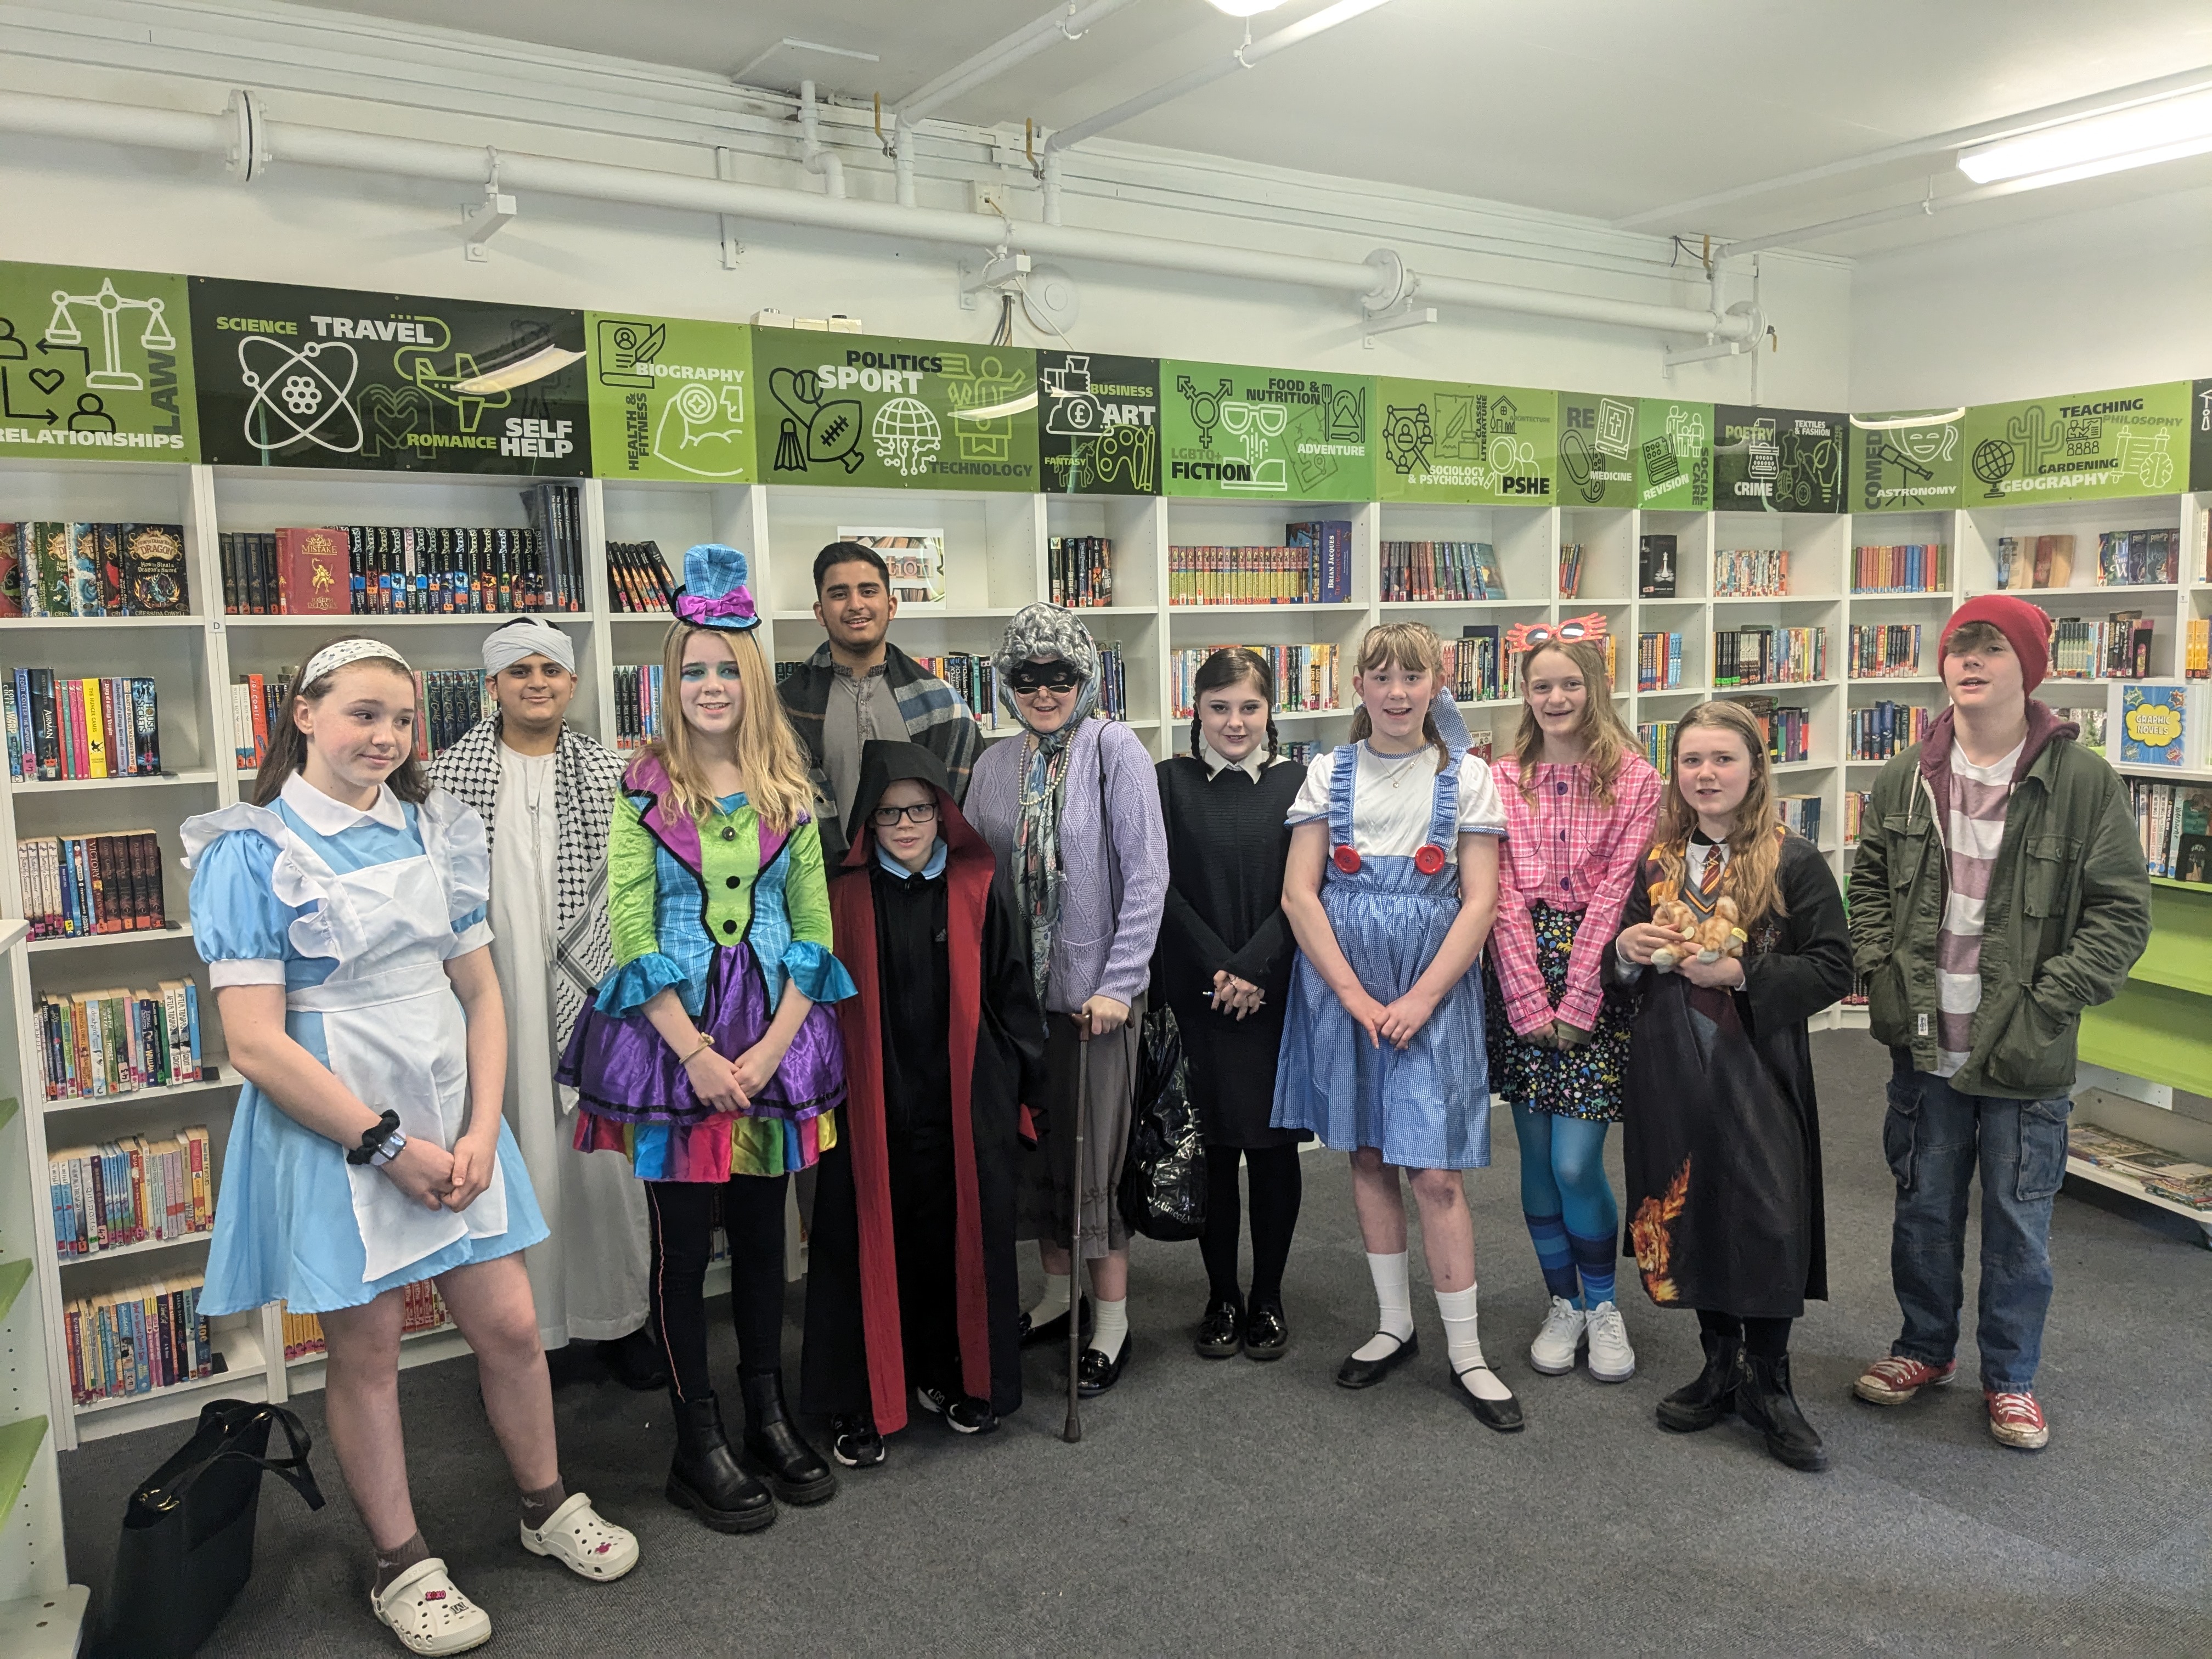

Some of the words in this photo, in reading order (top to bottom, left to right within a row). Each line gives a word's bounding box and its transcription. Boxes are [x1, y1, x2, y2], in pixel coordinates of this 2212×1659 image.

[217, 317, 298, 335] SCIENCE
[311, 315, 433, 344] TRAVEL
[847, 350, 943, 373] POLITICS
[636, 363, 744, 382] BIOGRAPHY
[818, 364, 923, 394] SPORT
[148, 350, 180, 435] LAW
[1091, 383, 1153, 397] BUSINESS
[1268, 378, 1305, 392] FOOD
[1309, 381, 1320, 393] &
[626, 392, 636, 405] &
[1246, 388, 1321, 405] NUTRITION
[1102, 404, 1155, 425] ART
[2060, 398, 2143, 419] TEACHING
[637, 393, 649, 456] FITNESS
[1567, 407, 1595, 429] RE
[1795, 420, 1826, 428] TEXTILES
[2102, 414, 2183, 427] PHILOSOPHY
[506, 418, 572, 438] SELF
[1725, 425, 1774, 441] POETRY
[1802, 428, 1830, 436] FASHION
[407, 433, 496, 449] ROMANCE
[500, 437, 573, 458] HELP
[626, 410, 639, 471] HEALTH
[1171, 448, 1221, 461] LGBTQ+
[1297, 443, 1365, 456] ADVENTURE
[929, 461, 1032, 477] TECHNOLOGY
[1045, 457, 1086, 466] FANTASY
[1865, 416, 1882, 509] COMED
[2038, 458, 2118, 474] GARDENING
[1171, 462, 1251, 481] FICTION
[1430, 465, 1484, 477] SOCIOLOGY
[1590, 471, 1632, 482] MEDICINE
[1408, 474, 1417, 484] &
[1420, 474, 1485, 486] PSYCHOLOGY
[1503, 476, 1550, 495] PSHE
[1643, 473, 1690, 501] REVISION
[1692, 462, 1701, 506] CARE
[2000, 472, 2109, 493] GEOGRAPHY
[1734, 482, 1773, 496] CRIME
[1876, 486, 1956, 498] ASTRONOMY
[140, 544, 174, 556] DRAGON
[302, 545, 337, 554] MISTAKE
[6, 712, 18, 734] WARP
[43, 709, 54, 739] AIRMAN
[137, 699, 146, 733] SECRETS
[145, 702, 155, 731] HOUSE
[2136, 715, 2171, 724] GRAPHIC
[2137, 725, 2169, 735] NOVELS
[89, 841, 100, 880] VICTORY
[425, 1590, 446, 1601] XOXO
